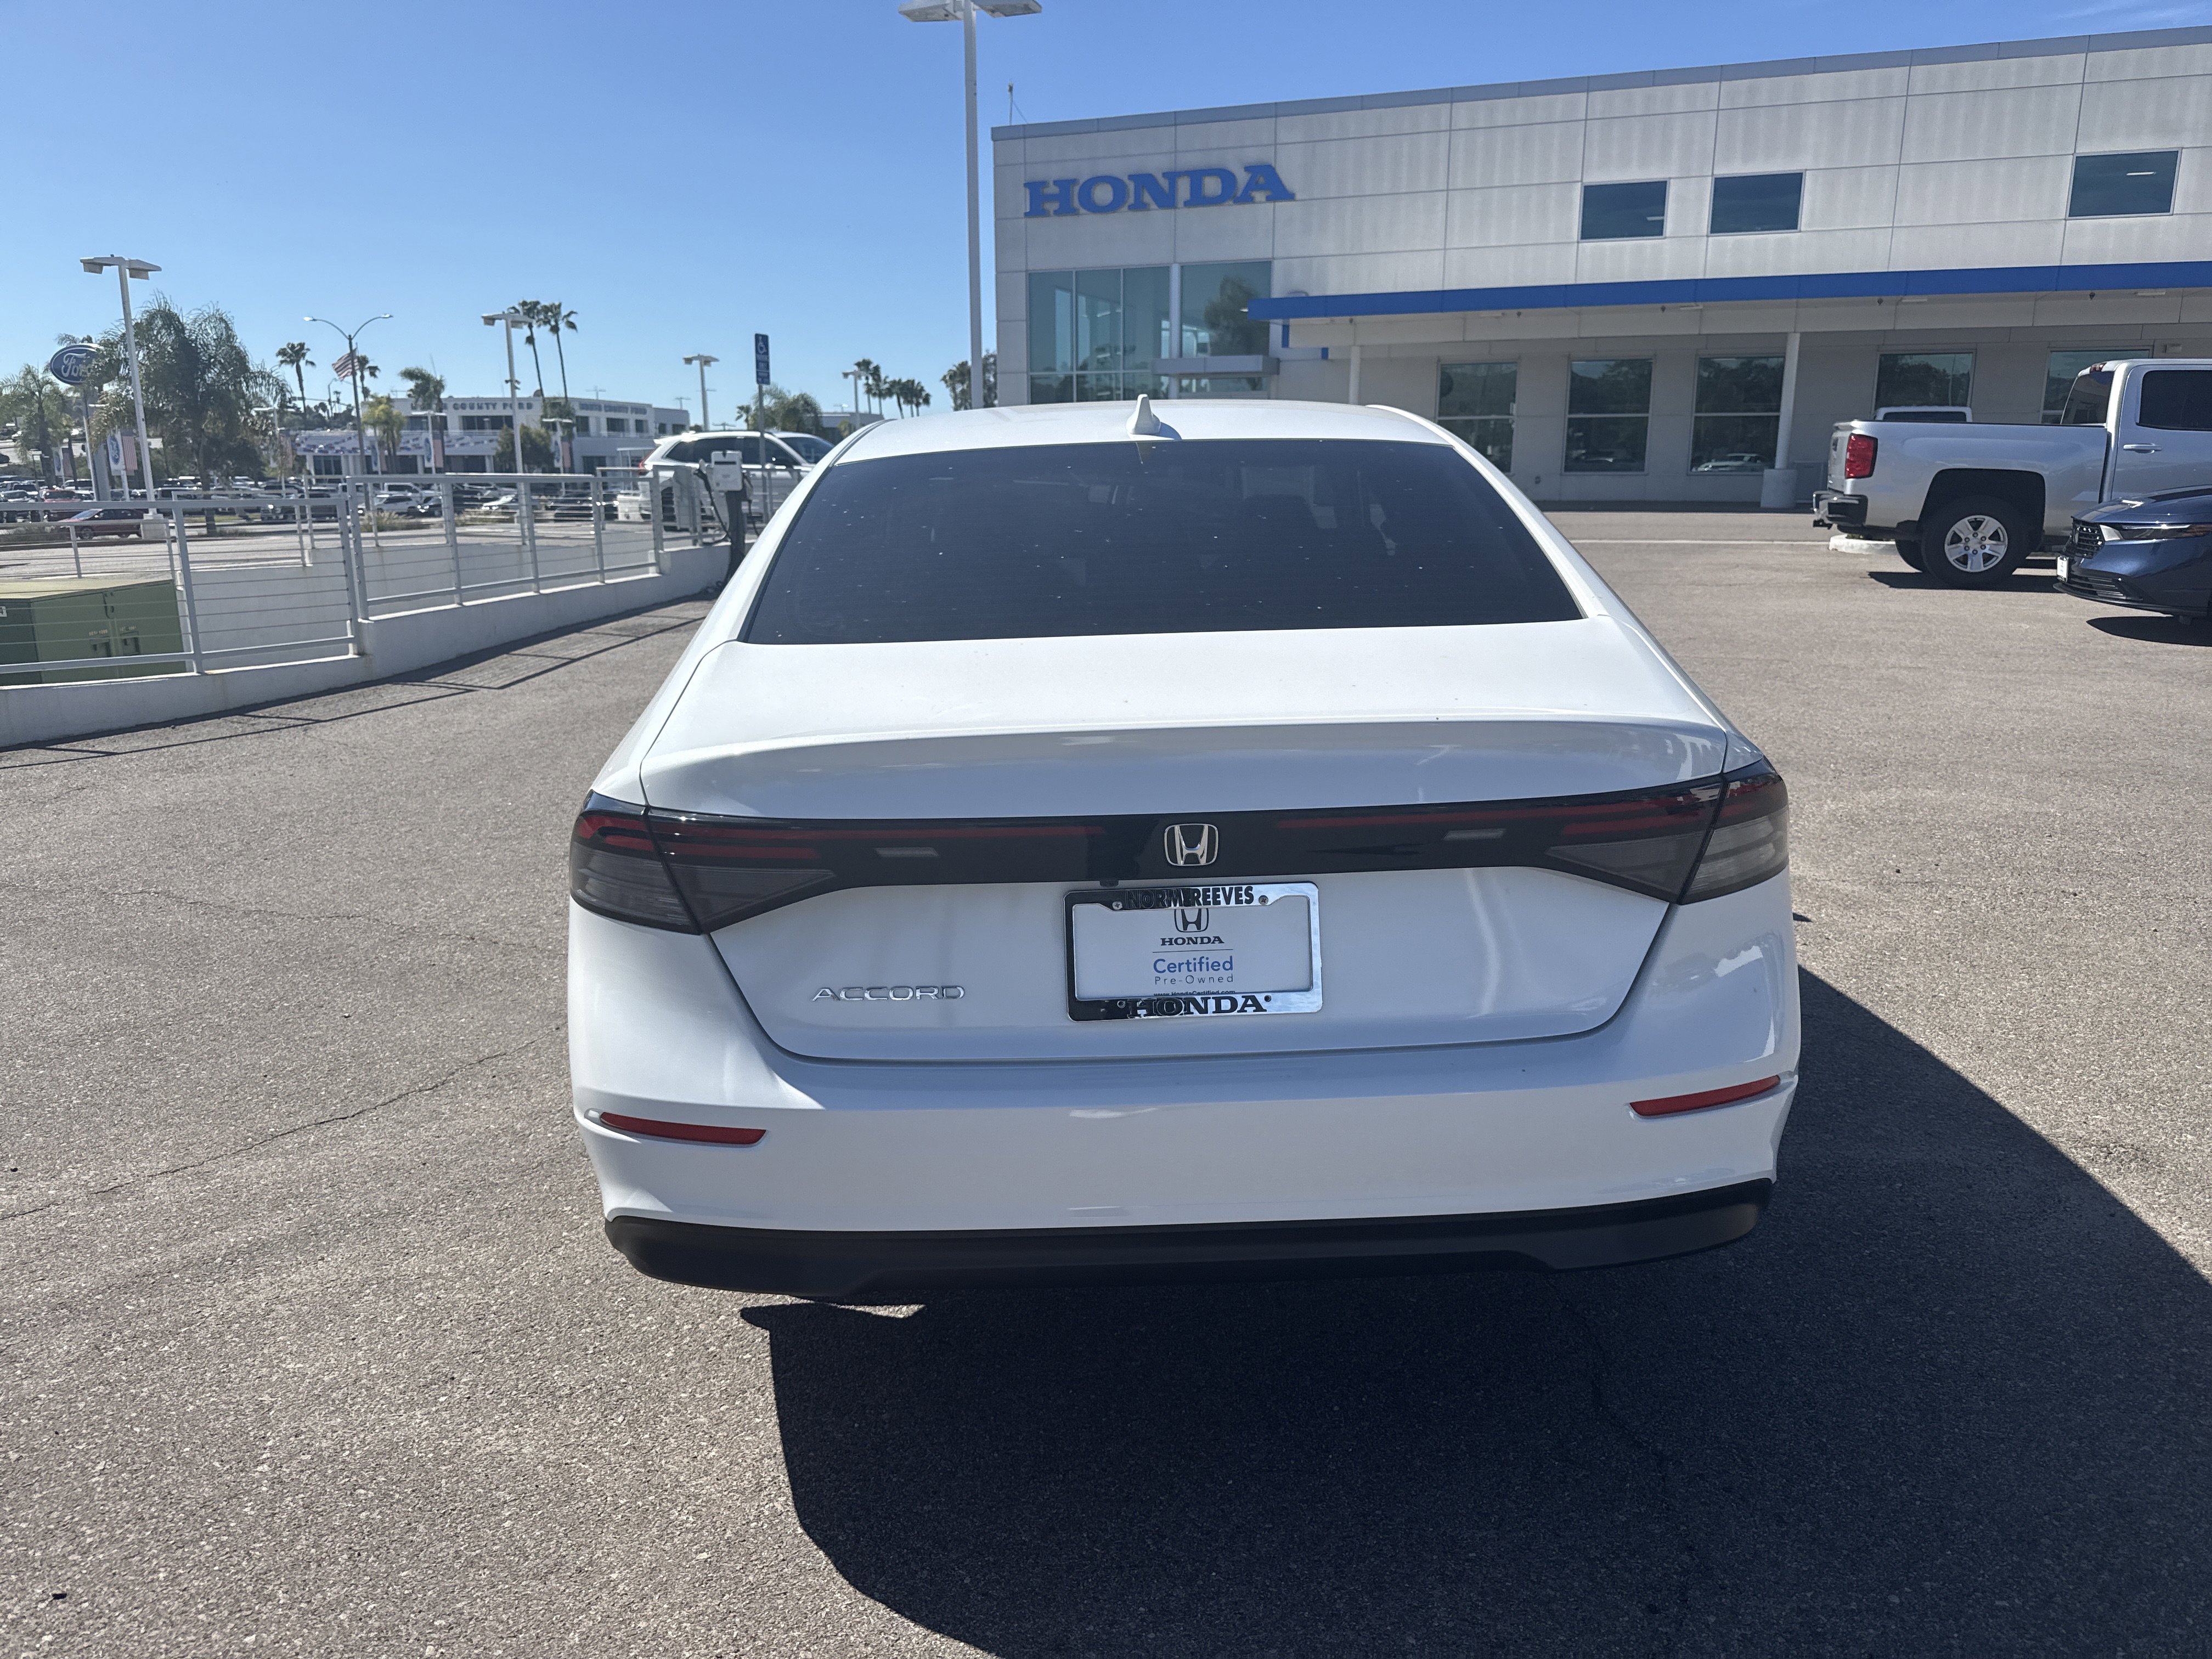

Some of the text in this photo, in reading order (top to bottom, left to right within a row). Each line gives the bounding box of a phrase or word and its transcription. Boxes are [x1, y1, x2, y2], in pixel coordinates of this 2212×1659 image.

[1024, 164, 1295, 218] HONDA
[453, 402, 497, 410] COUNTY
[1125, 885, 1254, 909] NORM REEVES
[1160, 936, 1224, 946] HONDA
[1153, 955, 1233, 973] Certified
[1155, 973, 1233, 985] Pre-Owned
[811, 985, 966, 1001] ACCORD
[1127, 995, 1267, 1018] HONDA
